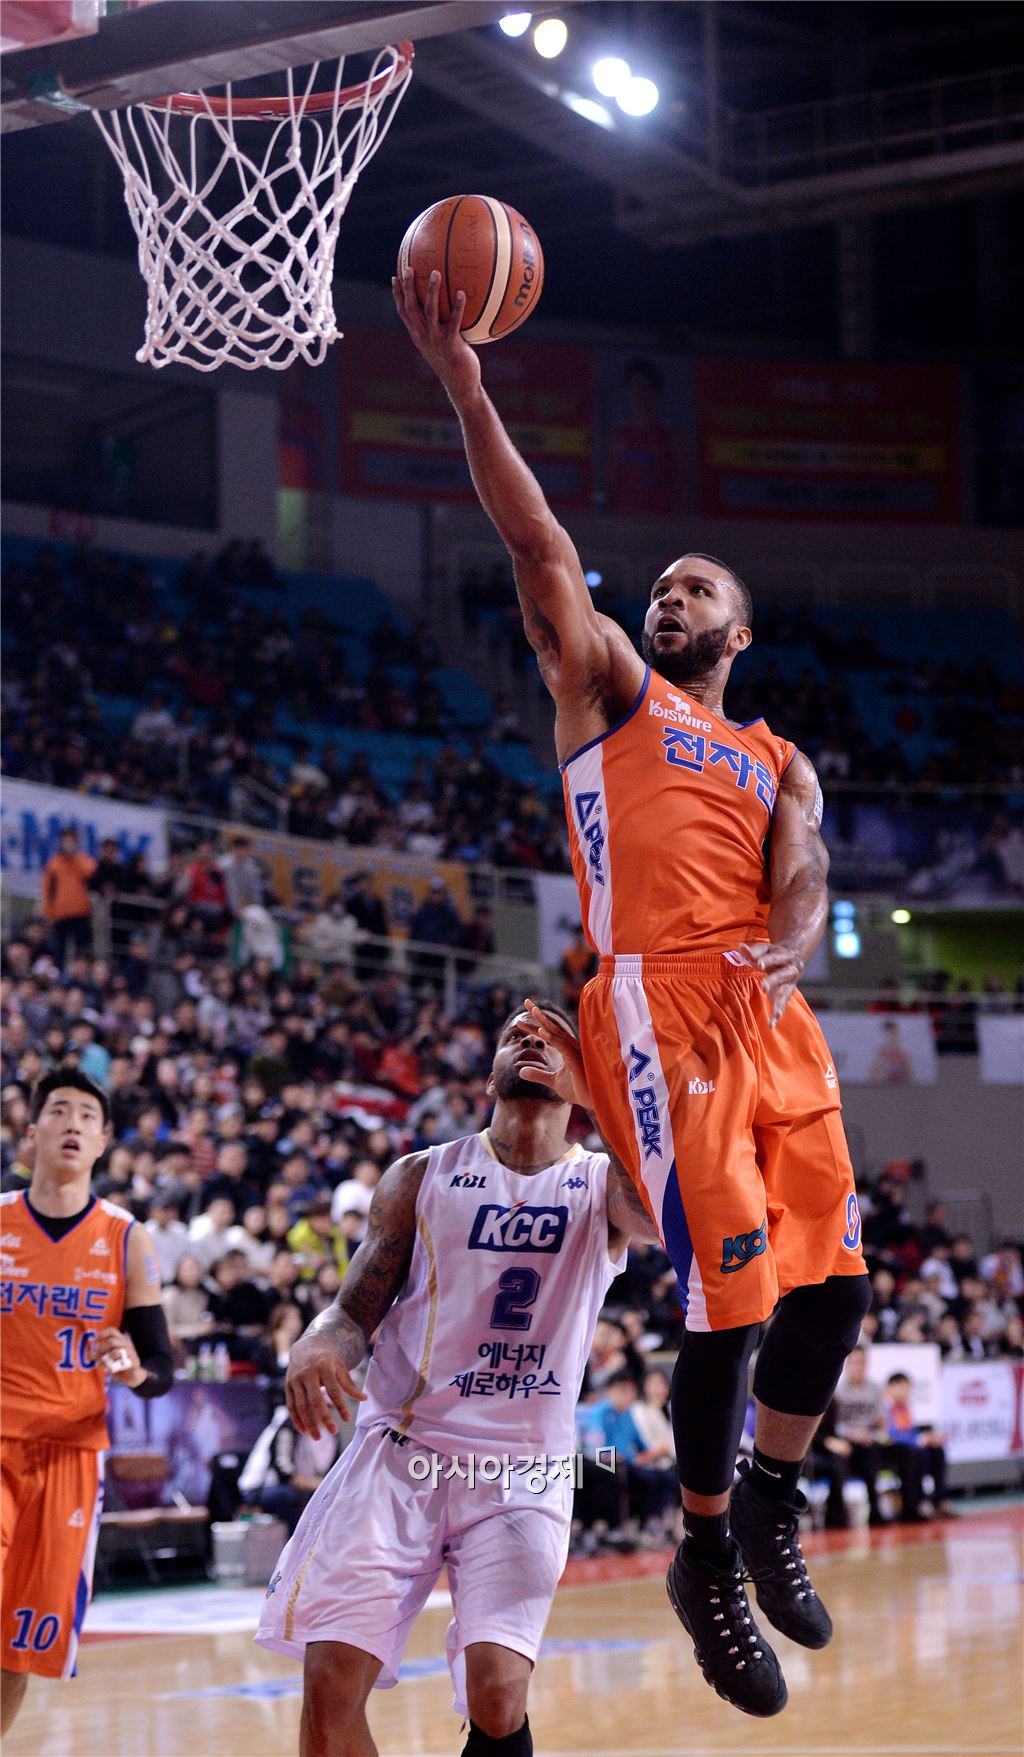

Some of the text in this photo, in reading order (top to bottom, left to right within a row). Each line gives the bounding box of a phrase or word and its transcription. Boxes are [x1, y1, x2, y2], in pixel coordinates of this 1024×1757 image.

[632, 1086, 663, 1161] PEAK
[450, 1173, 487, 1189] KBL
[478, 1203, 560, 1247] KCC
[490, 1266, 541, 1331] 2
[56, 1326, 98, 1371] 10
[478, 1342, 546, 1370] 에너지
[449, 1371, 562, 1399] 제로하우스
[11, 1607, 61, 1652] 10
